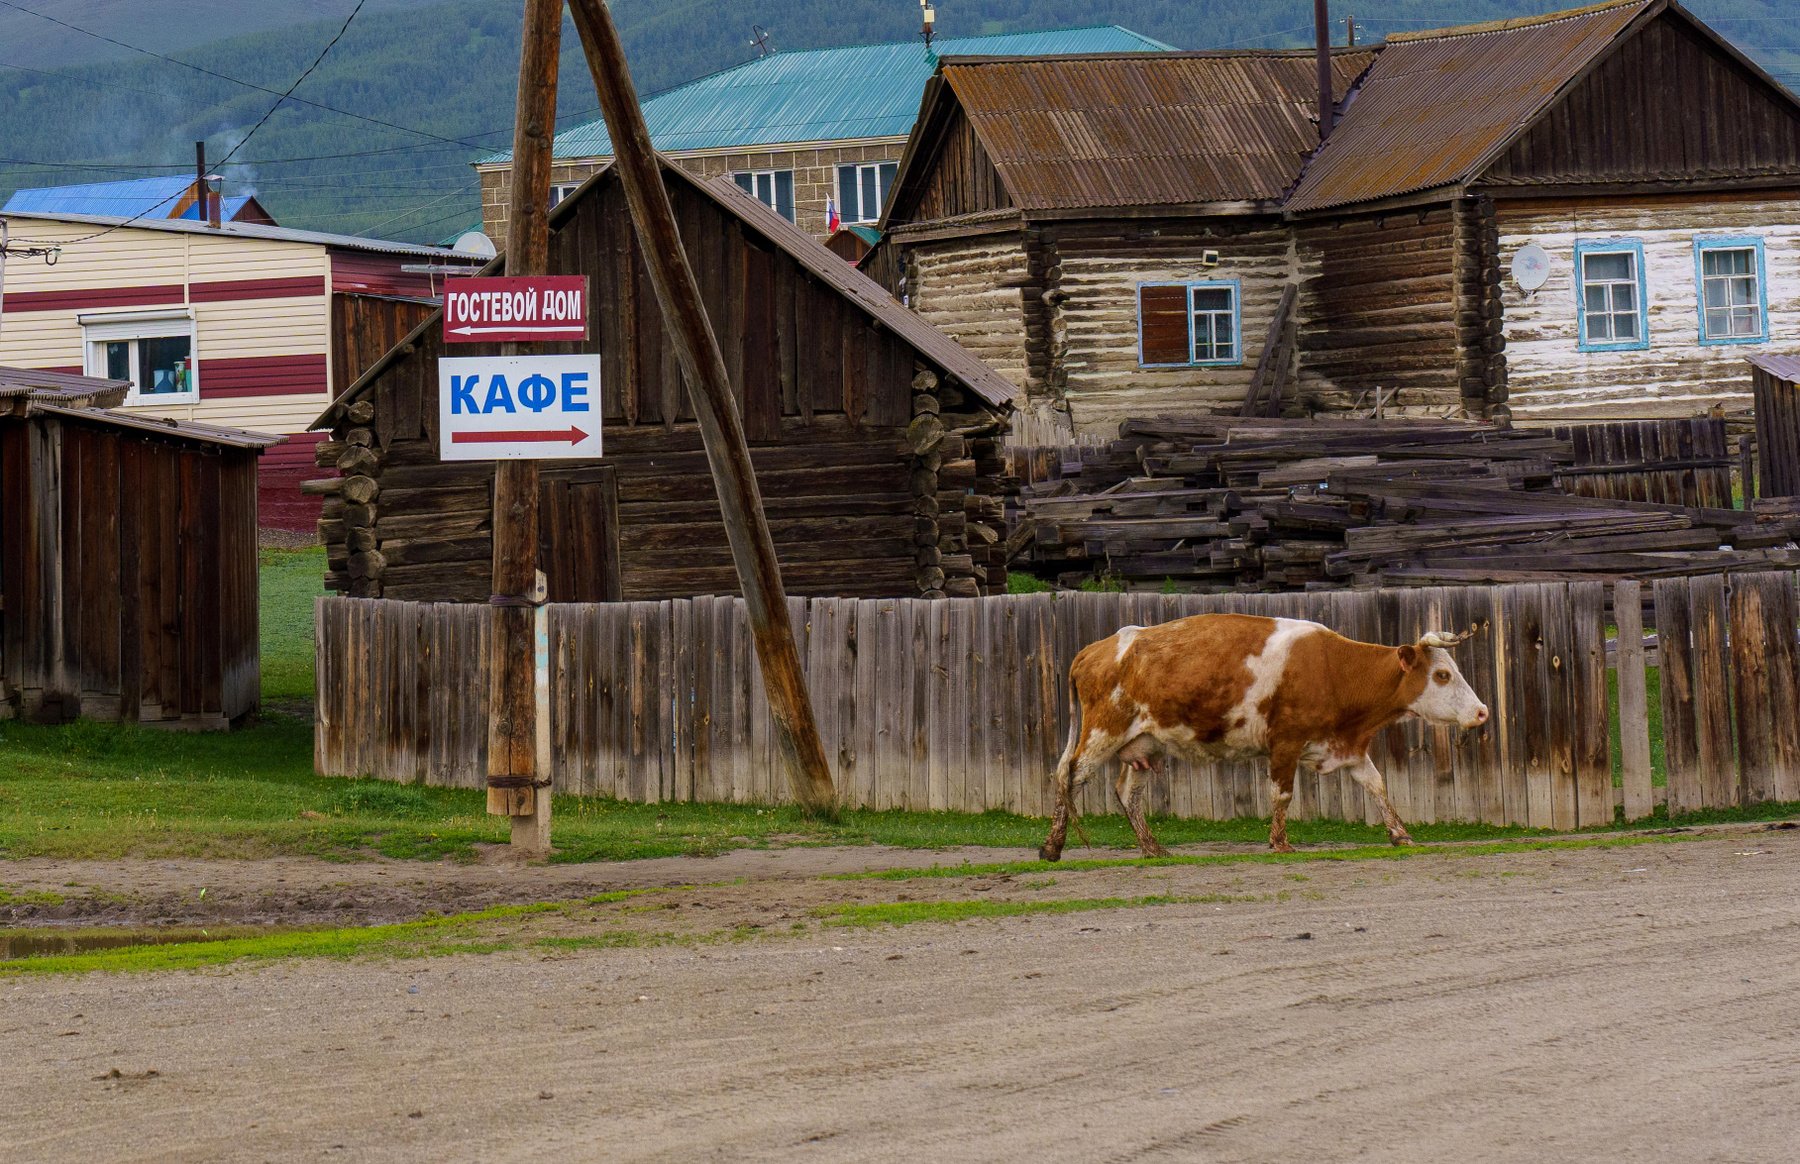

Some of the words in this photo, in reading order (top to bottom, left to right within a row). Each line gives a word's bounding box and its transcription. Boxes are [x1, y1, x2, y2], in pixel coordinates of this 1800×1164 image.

[447, 287, 537, 322] ГОСТЕВОЙ
[542, 290, 581, 321] ДОМ
[450, 372, 590, 415] КАФЕ
